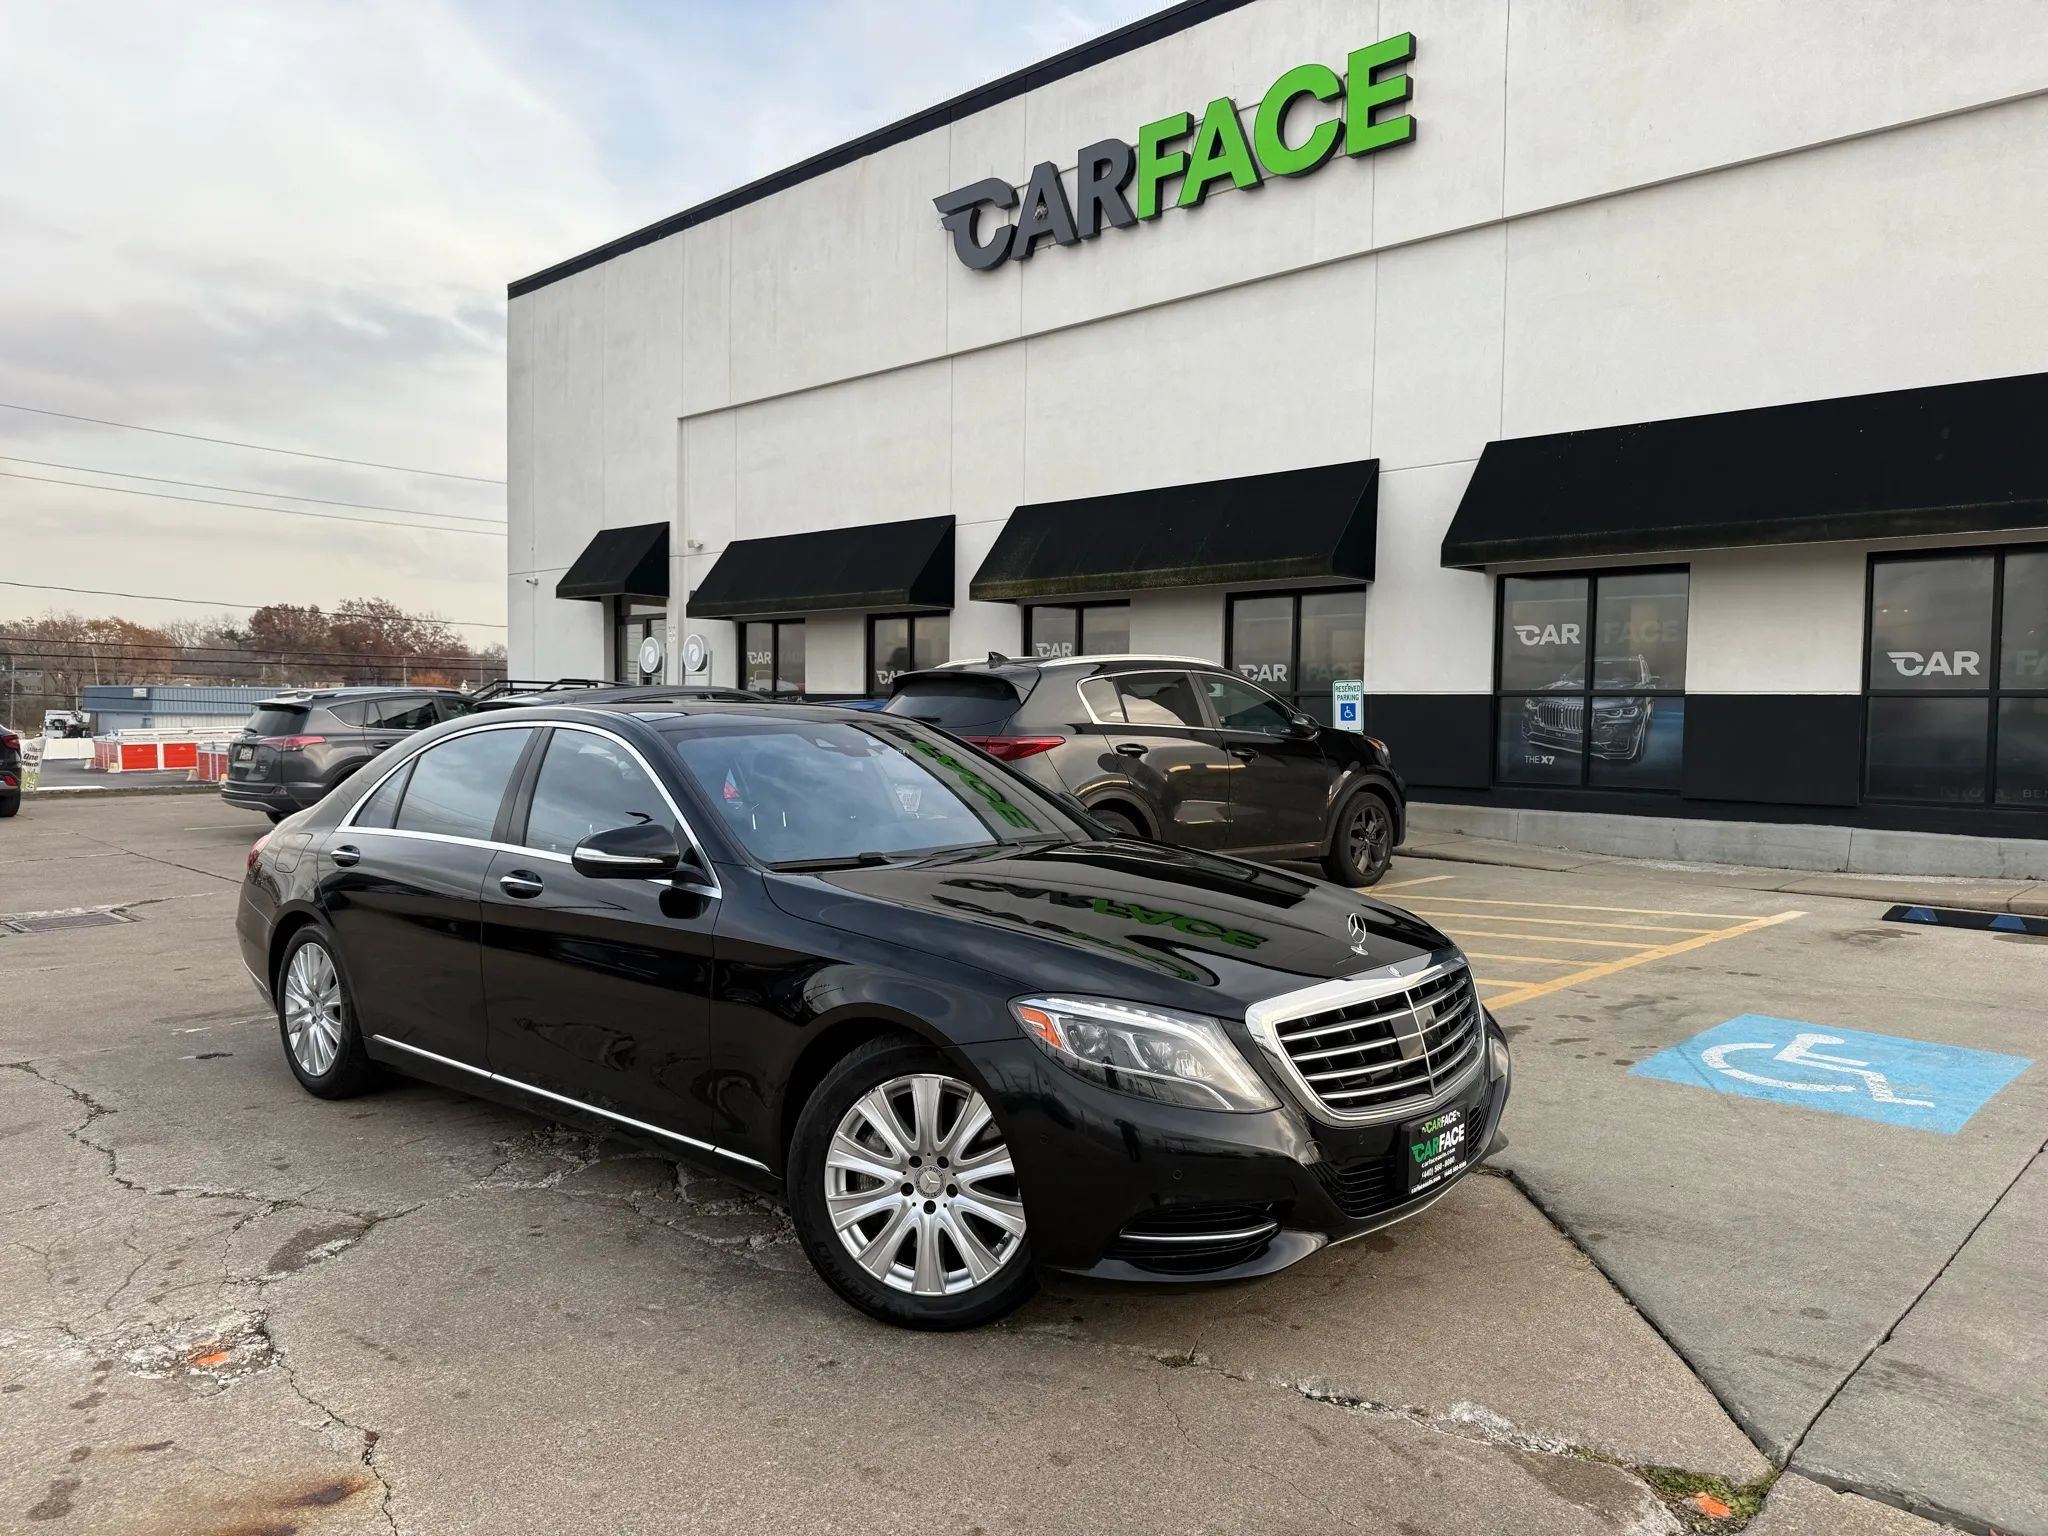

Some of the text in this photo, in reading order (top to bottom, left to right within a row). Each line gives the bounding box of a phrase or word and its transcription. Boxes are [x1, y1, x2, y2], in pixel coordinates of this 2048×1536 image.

[933, 31, 1417, 271] CARFACE
[1513, 623, 1581, 646] CAR
[748, 651, 772, 665] CAR
[1036, 643, 1073, 658] CAR
[1239, 664, 1288, 682] CAR
[1887, 651, 1981, 677] CAR
[1335, 685, 1361, 693] RESERVED
[1336, 694, 1360, 702] PARKING
[1525, 755, 1555, 765] THE X7
[1424, 1110, 1458, 1133] CARFACE
[1411, 1123, 1465, 1163] CARFACE
